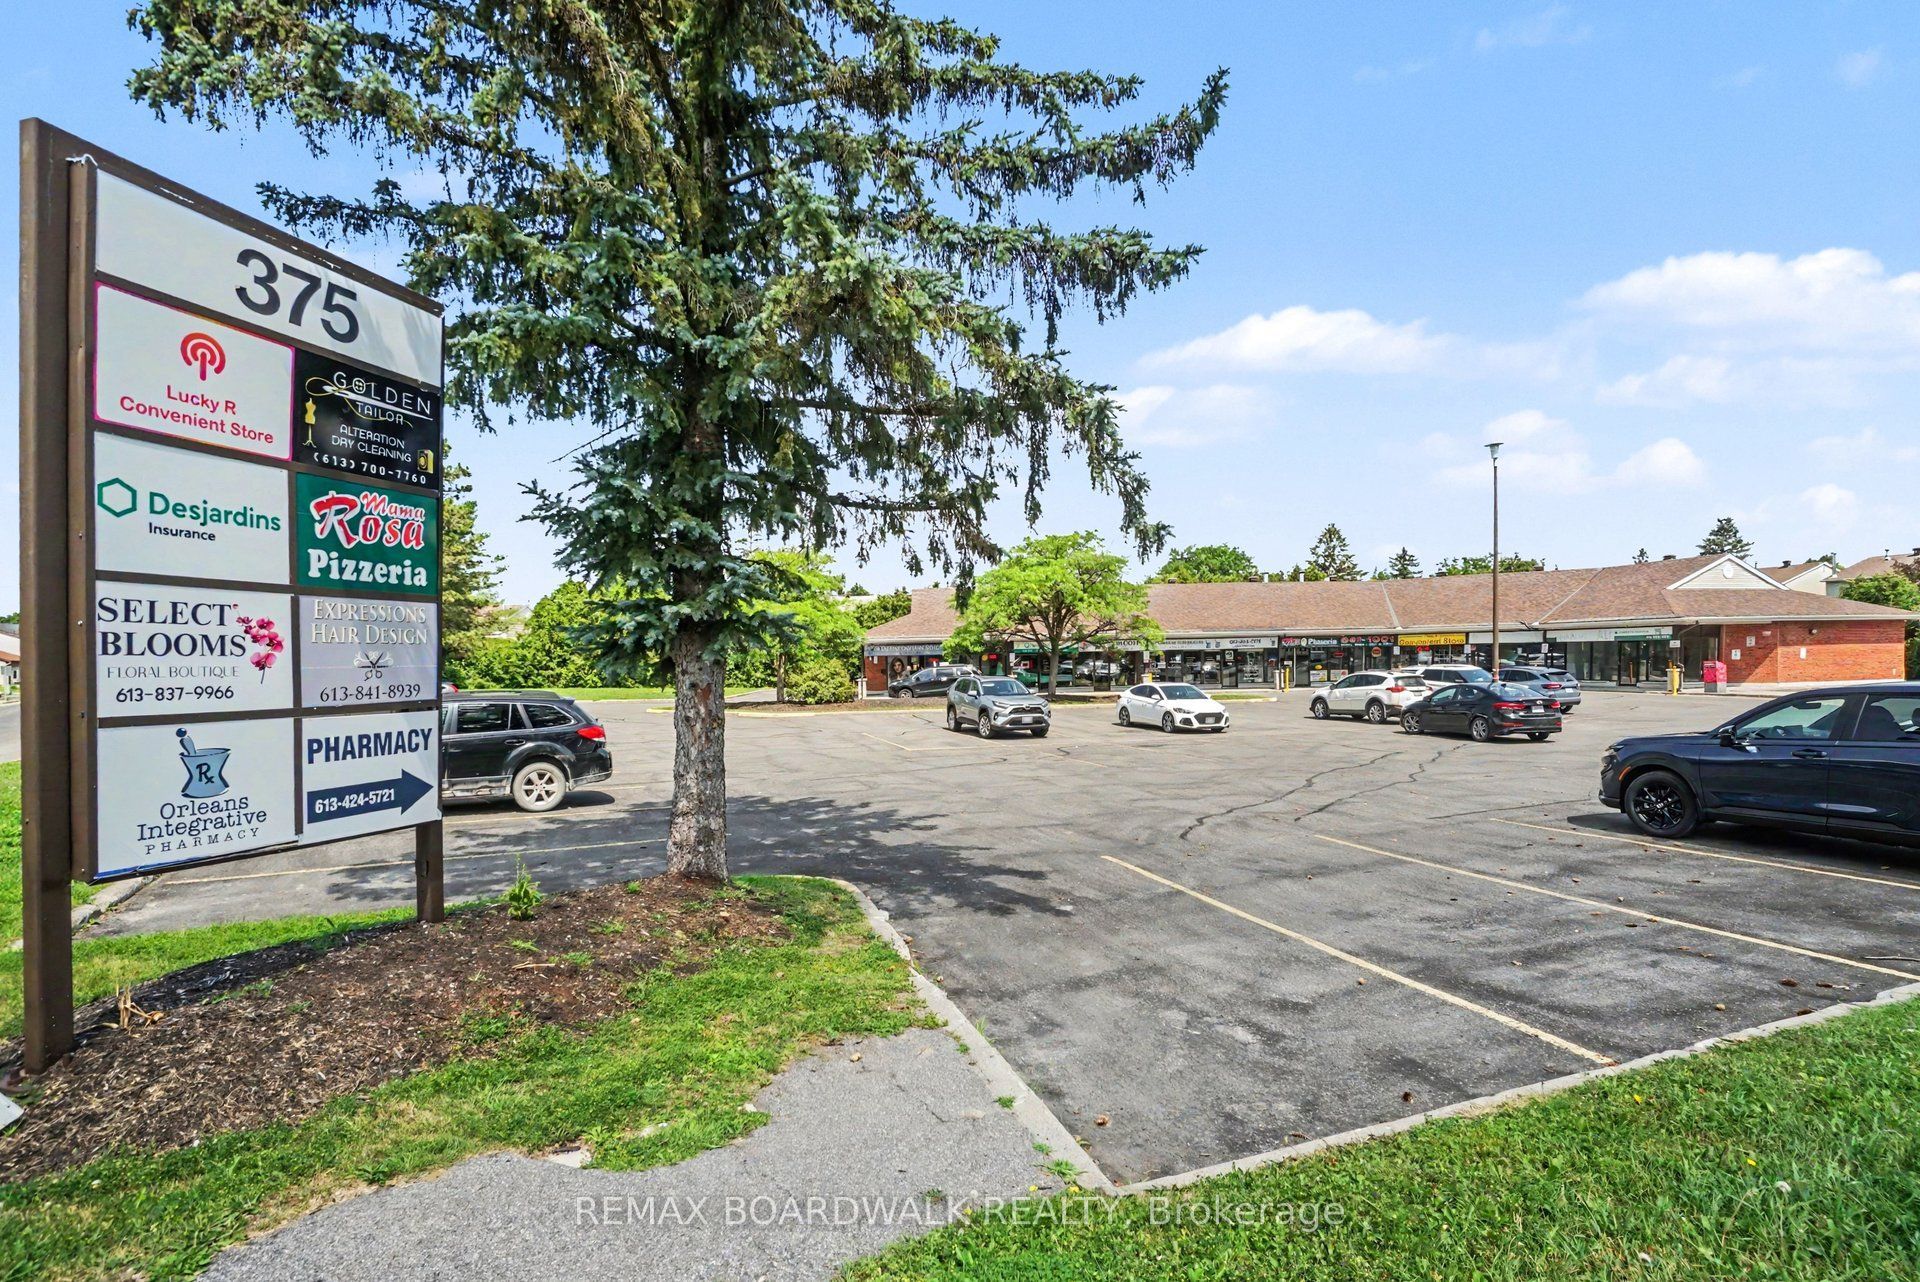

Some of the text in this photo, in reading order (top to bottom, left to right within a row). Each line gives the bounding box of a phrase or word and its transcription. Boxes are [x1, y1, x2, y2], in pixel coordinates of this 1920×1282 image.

[235, 248, 359, 344] 375
[166, 385, 236, 414] Lucky R
[333, 372, 431, 415] GOLDEN
[120, 397, 274, 444] Convenient Store
[356, 402, 404, 425] TAILOR
[332, 436, 411, 462] DRY CLEANING
[340, 425, 405, 448] ALTERATION
[313, 452, 426, 484] (613) 700-7760
[149, 492, 281, 532] Desjardins
[361, 492, 425, 521] Mama
[149, 522, 216, 542] Insurance
[312, 493, 425, 549] Rosa
[308, 549, 427, 587] Pizzeria
[97, 598, 232, 626] SELECT
[314, 600, 426, 624] EXPRESSIONS
[99, 633, 246, 657] BLOOMS
[311, 624, 427, 645] HAIR DESIGN
[107, 665, 239, 679] FLORAL BOUTIQUE
[116, 685, 234, 702] 613-837-9966
[320, 684, 421, 702] 613-841-8939
[307, 729, 432, 764] PHARMACY
[160, 796, 248, 819] Orleans
[315, 789, 394, 814] 613-424-5721
[137, 808, 267, 841] Integrative
[146, 828, 259, 855] PHARMACY
